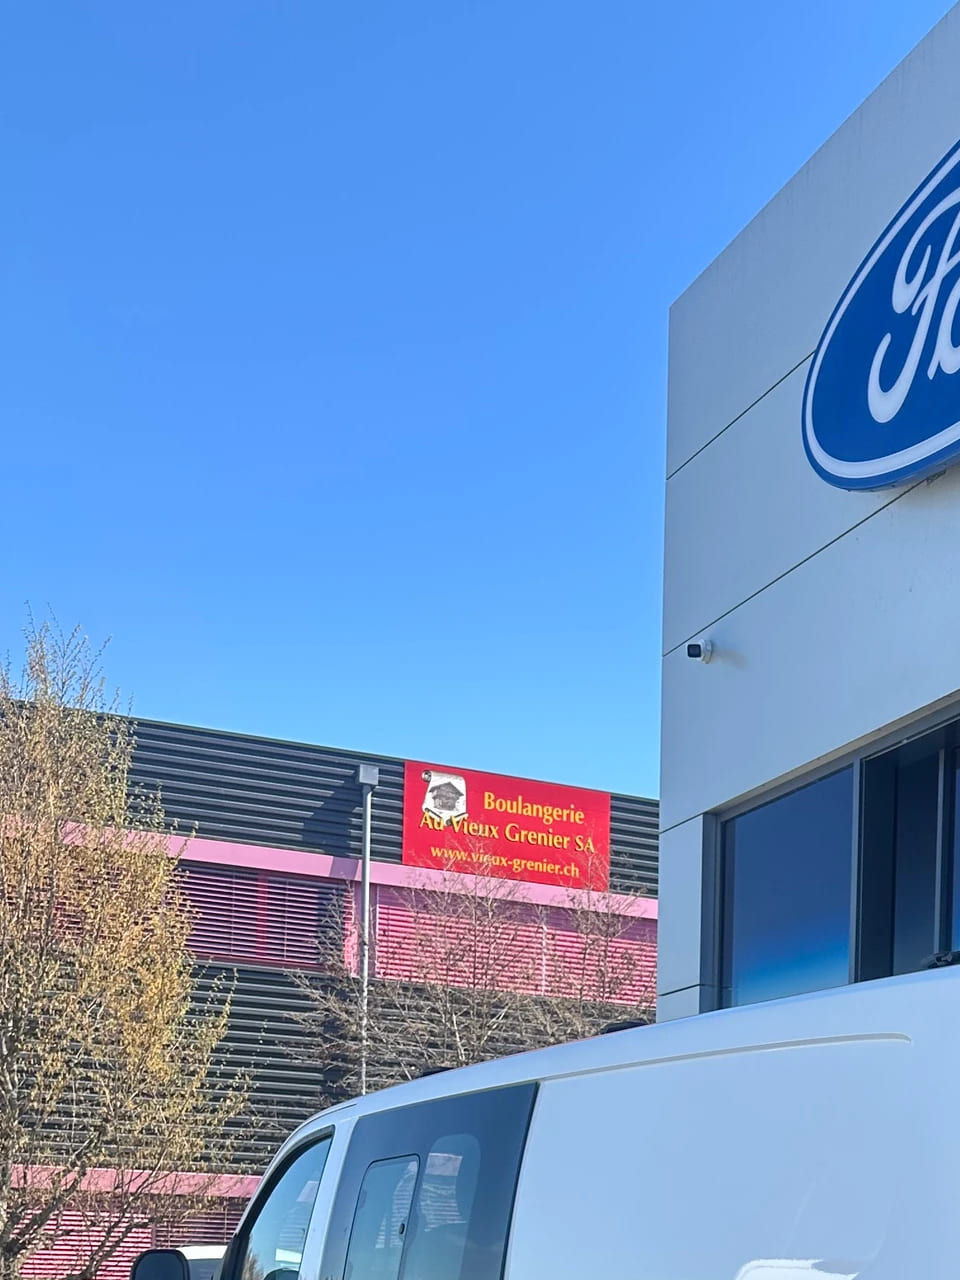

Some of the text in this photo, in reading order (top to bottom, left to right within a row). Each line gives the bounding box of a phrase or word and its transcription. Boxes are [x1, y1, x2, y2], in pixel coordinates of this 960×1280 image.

[484, 791, 585, 825] Boulangerie
[419, 810, 595, 853] Au Vieux Grenier SA
[430, 846, 580, 878] www.vieux-grenier.ch
